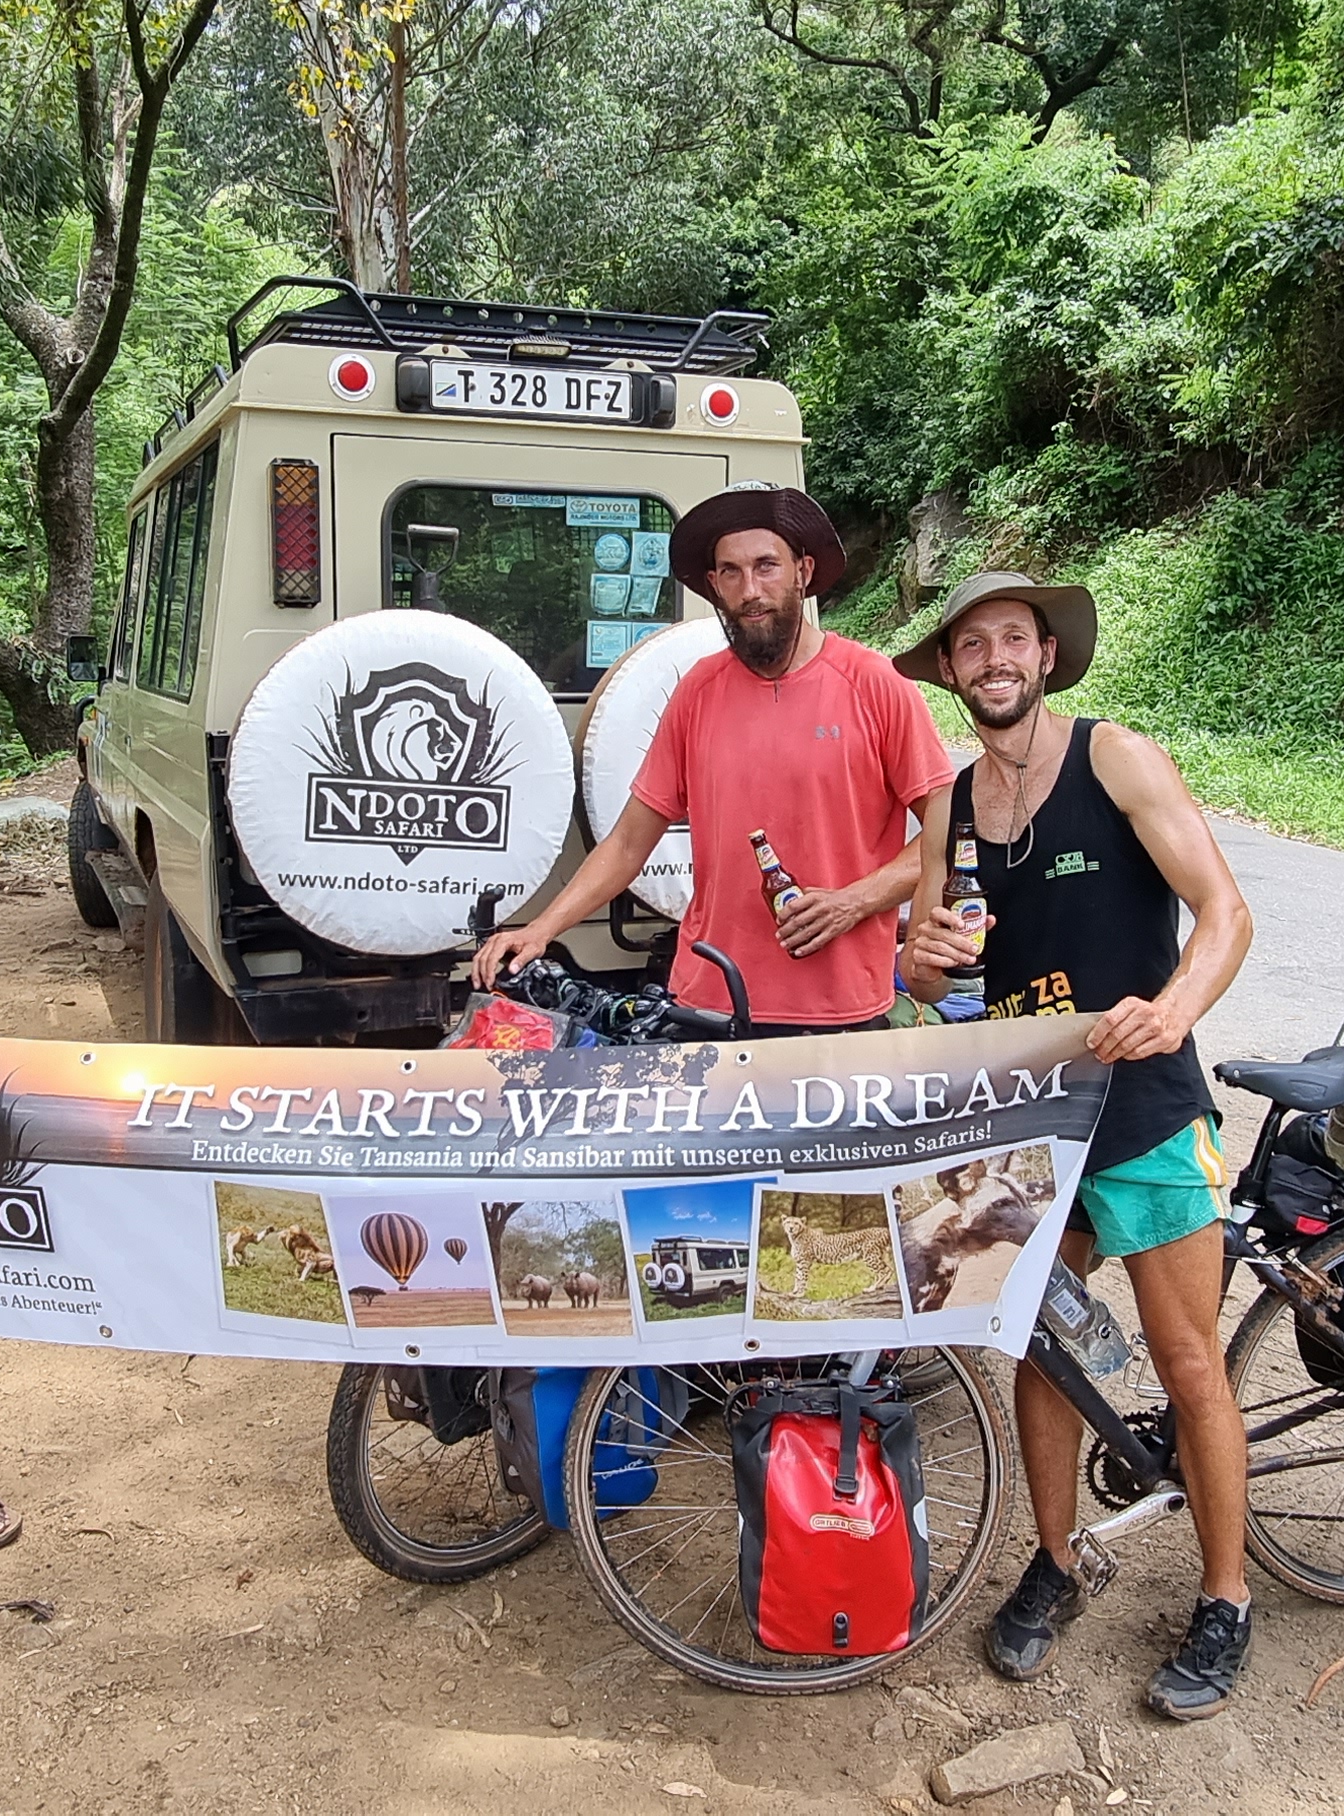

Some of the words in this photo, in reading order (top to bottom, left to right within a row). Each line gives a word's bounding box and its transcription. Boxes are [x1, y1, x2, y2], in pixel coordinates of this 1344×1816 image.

[457, 370, 474, 403] T
[489, 372, 547, 408] 328
[565, 377, 623, 413] DFZ
[589, 502, 637, 513] TOYOTA
[318, 787, 498, 839] NDOTO
[374, 819, 444, 839] SAFARI
[397, 845, 418, 854] LTD
[278, 871, 525, 896] www.ndoto-safari.com
[1030, 971, 1073, 1006] za
[127, 1082, 215, 1129] IT
[219, 1084, 486, 1138] STARTS
[505, 1084, 709, 1138] WITH
[718, 1080, 774, 1131] A
[789, 1060, 1073, 1129] DREAM
[191, 1139, 313, 1166] Entdecken
[318, 1144, 354, 1168] Sie
[360, 1144, 463, 1168] Tansania
[469, 1147, 516, 1169] und
[522, 1144, 626, 1169] Sansibar
[631, 1142, 676, 1168] mit
[681, 1146, 784, 1167] unseren
[790, 1140, 909, 1165] exklusiven
[913, 1119, 993, 1155] Safaris!
